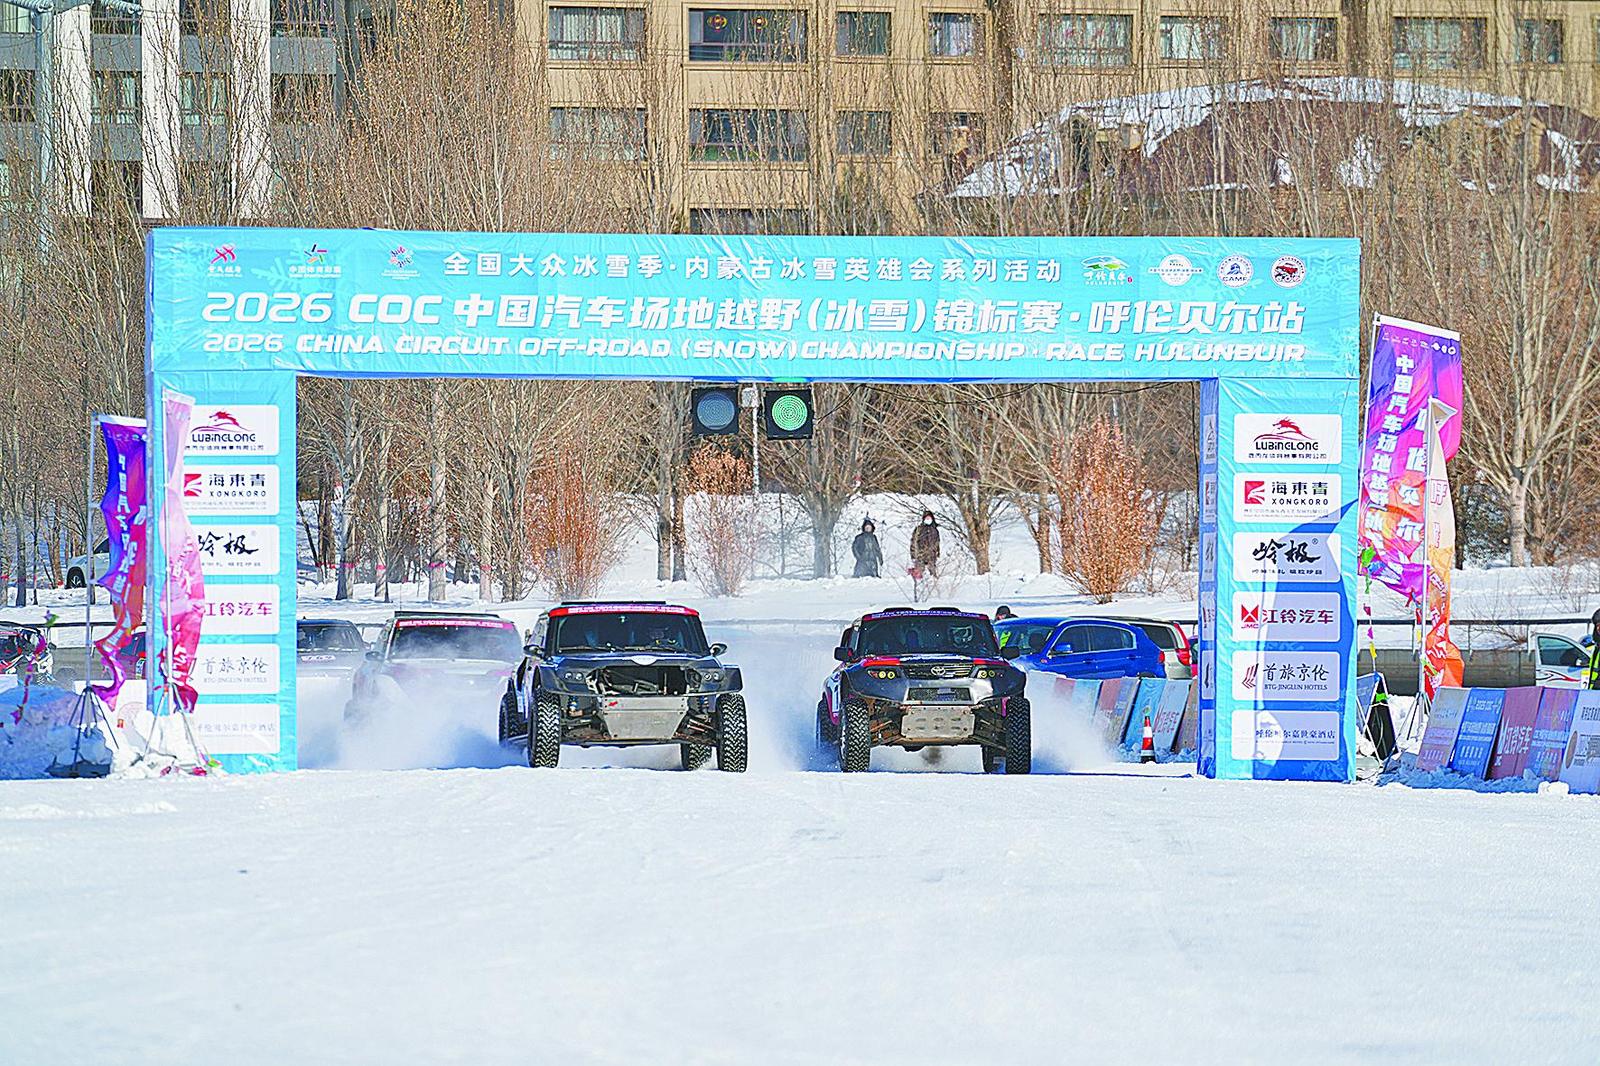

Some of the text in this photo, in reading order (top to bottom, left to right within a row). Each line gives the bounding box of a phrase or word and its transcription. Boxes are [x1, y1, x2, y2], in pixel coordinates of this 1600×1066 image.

[442, 251, 1061, 283] 全国大众冰雪季·内蒙古冰雪英雄会系列活动
[201, 292, 334, 323] 2026
[348, 294, 443, 324] COC
[203, 333, 284, 353] 2026
[296, 334, 384, 354] CHINA
[394, 335, 510, 356] CIRCUIT
[519, 337, 671, 357] OFF-ROAD
[1045, 343, 1126, 362] RACE
[1133, 343, 1306, 362] HULUNBUIR
[1262, 609, 1333, 624] 江铃汽车
[1262, 663, 1329, 681] 首旅京伦
